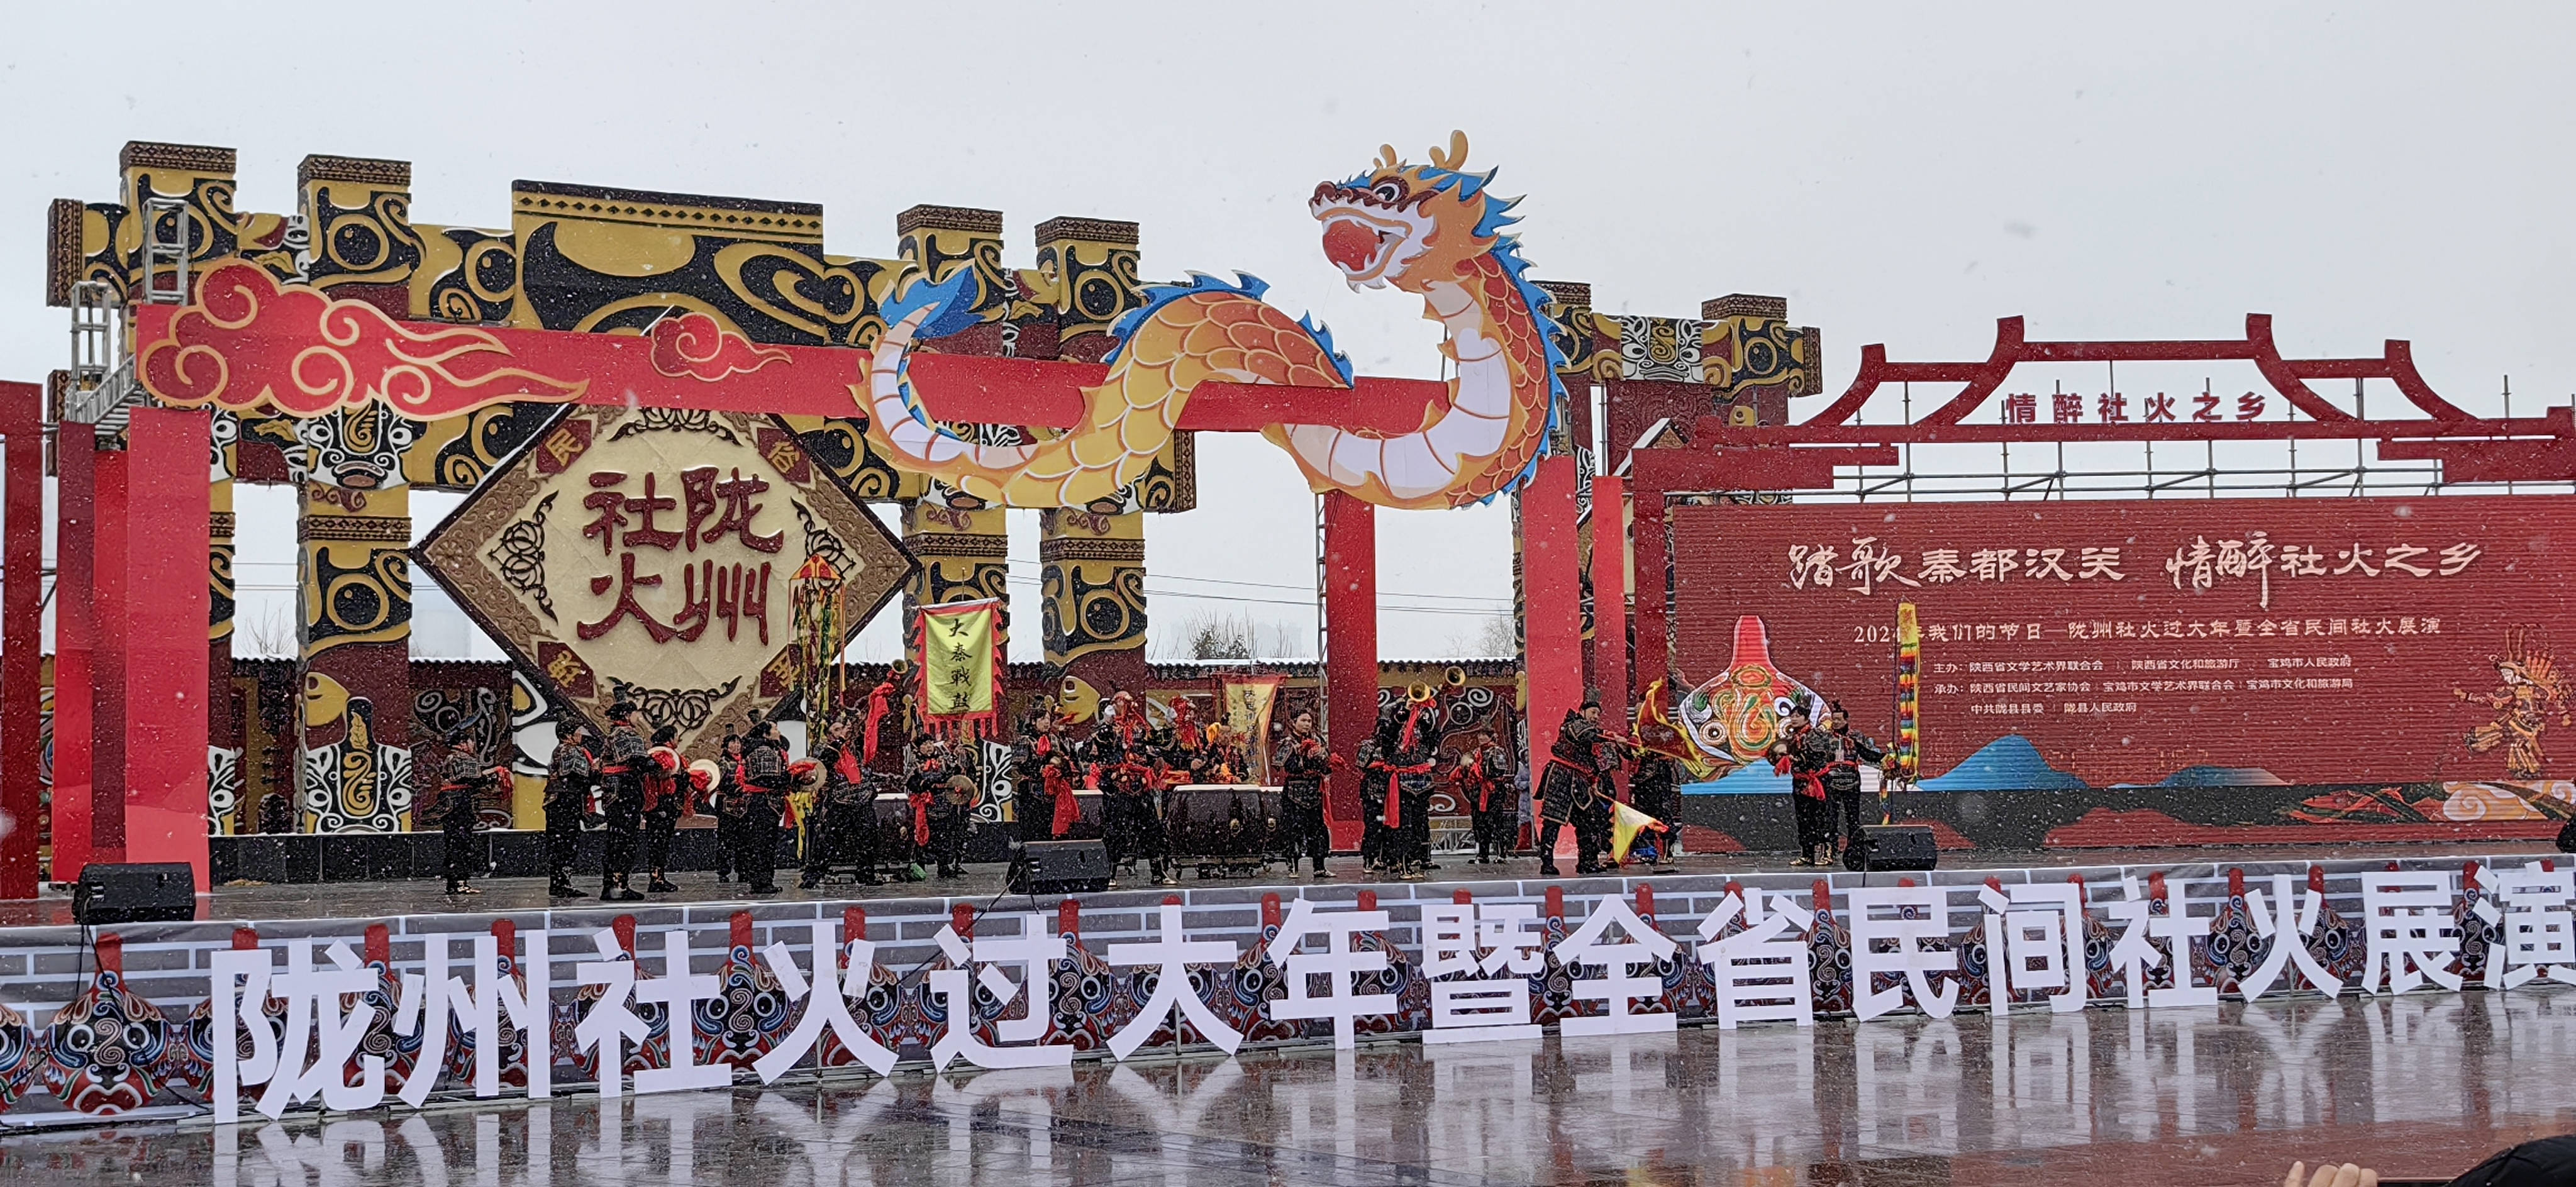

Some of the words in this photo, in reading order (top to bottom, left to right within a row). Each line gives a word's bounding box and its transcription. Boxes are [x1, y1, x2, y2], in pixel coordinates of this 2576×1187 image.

[2006, 391, 2265, 423] 情醉社火之乡
[545, 428, 584, 467] 民
[768, 440, 801, 473] 俗
[577, 472, 683, 644] 社火
[673, 466, 784, 646] 陇州
[1788, 536, 2126, 595] 踏歌秦都汉关
[2166, 531, 2484, 609] 情醉社火之乡
[2131, 658, 2240, 671] 陕西省文化和旅游厅
[2268, 656, 2351, 668] 宝鸡市人民政府
[2103, 679, 2235, 692] 宝鸡市文学艺术界联合会
[2246, 678, 2353, 690] 宝鸡市文化和旅游局
[1971, 702, 2044, 715] 中共陇县县委
[2063, 702, 2137, 714] 陇县人民政府
[210, 860, 2576, 1124] 陇州社火过大年暨全省民间社火展演
